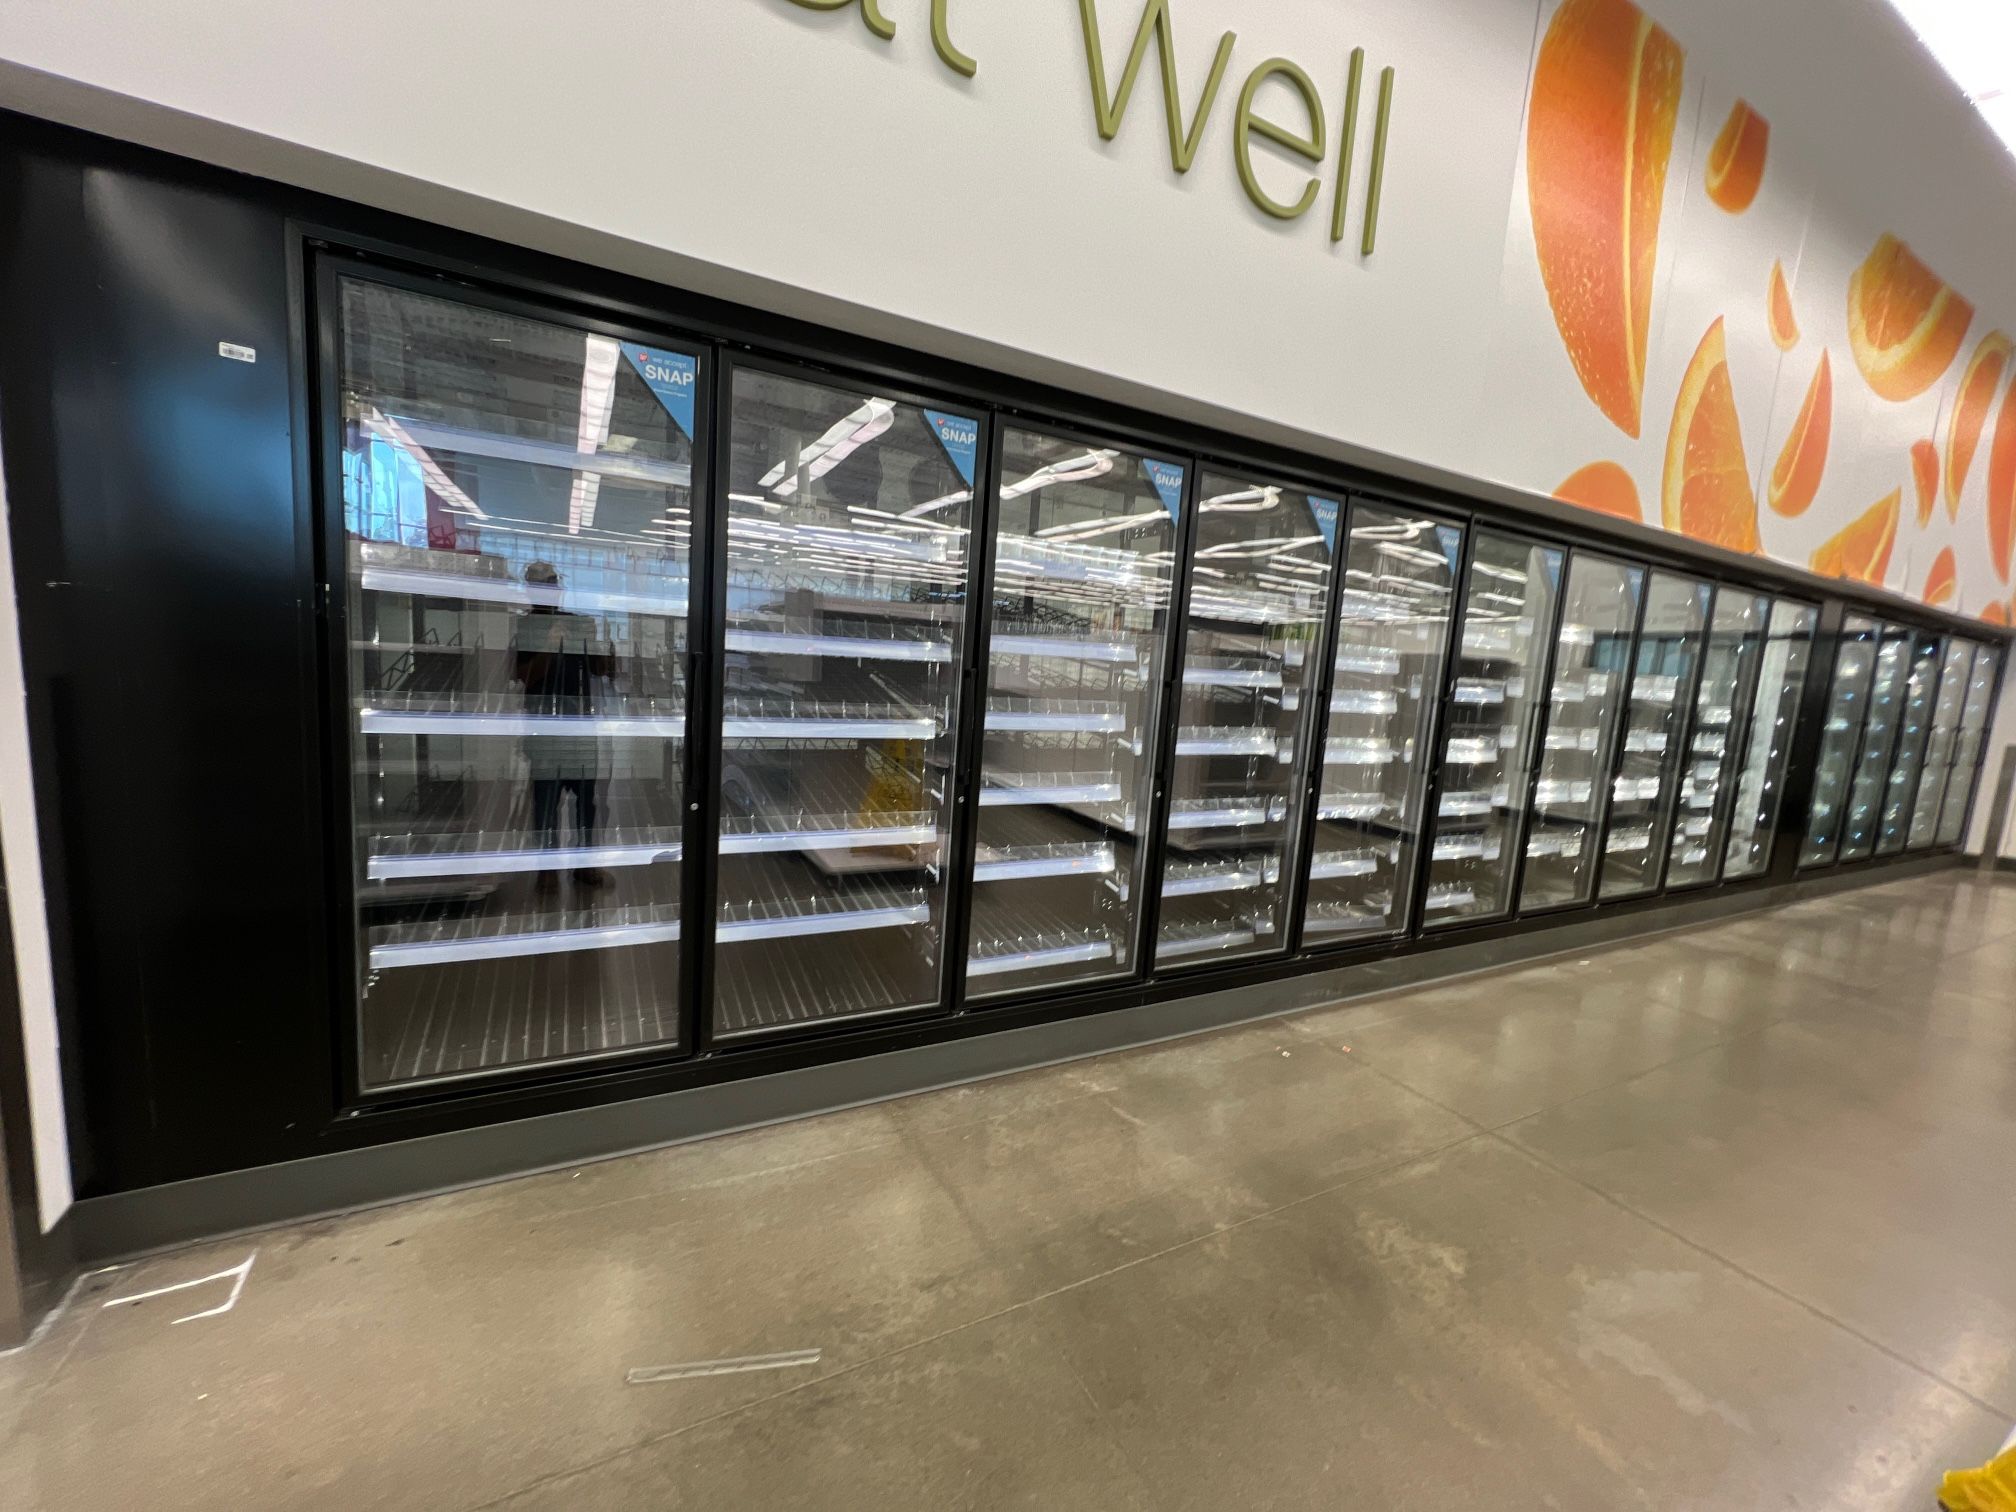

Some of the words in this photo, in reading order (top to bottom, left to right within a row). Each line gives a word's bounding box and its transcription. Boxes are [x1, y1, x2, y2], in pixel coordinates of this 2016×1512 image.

[1079, 0, 1394, 256] Well
[645, 364, 694, 387] SNAP
[941, 427, 977, 445] SNAP
[1155, 472, 1182, 489] SNAP
